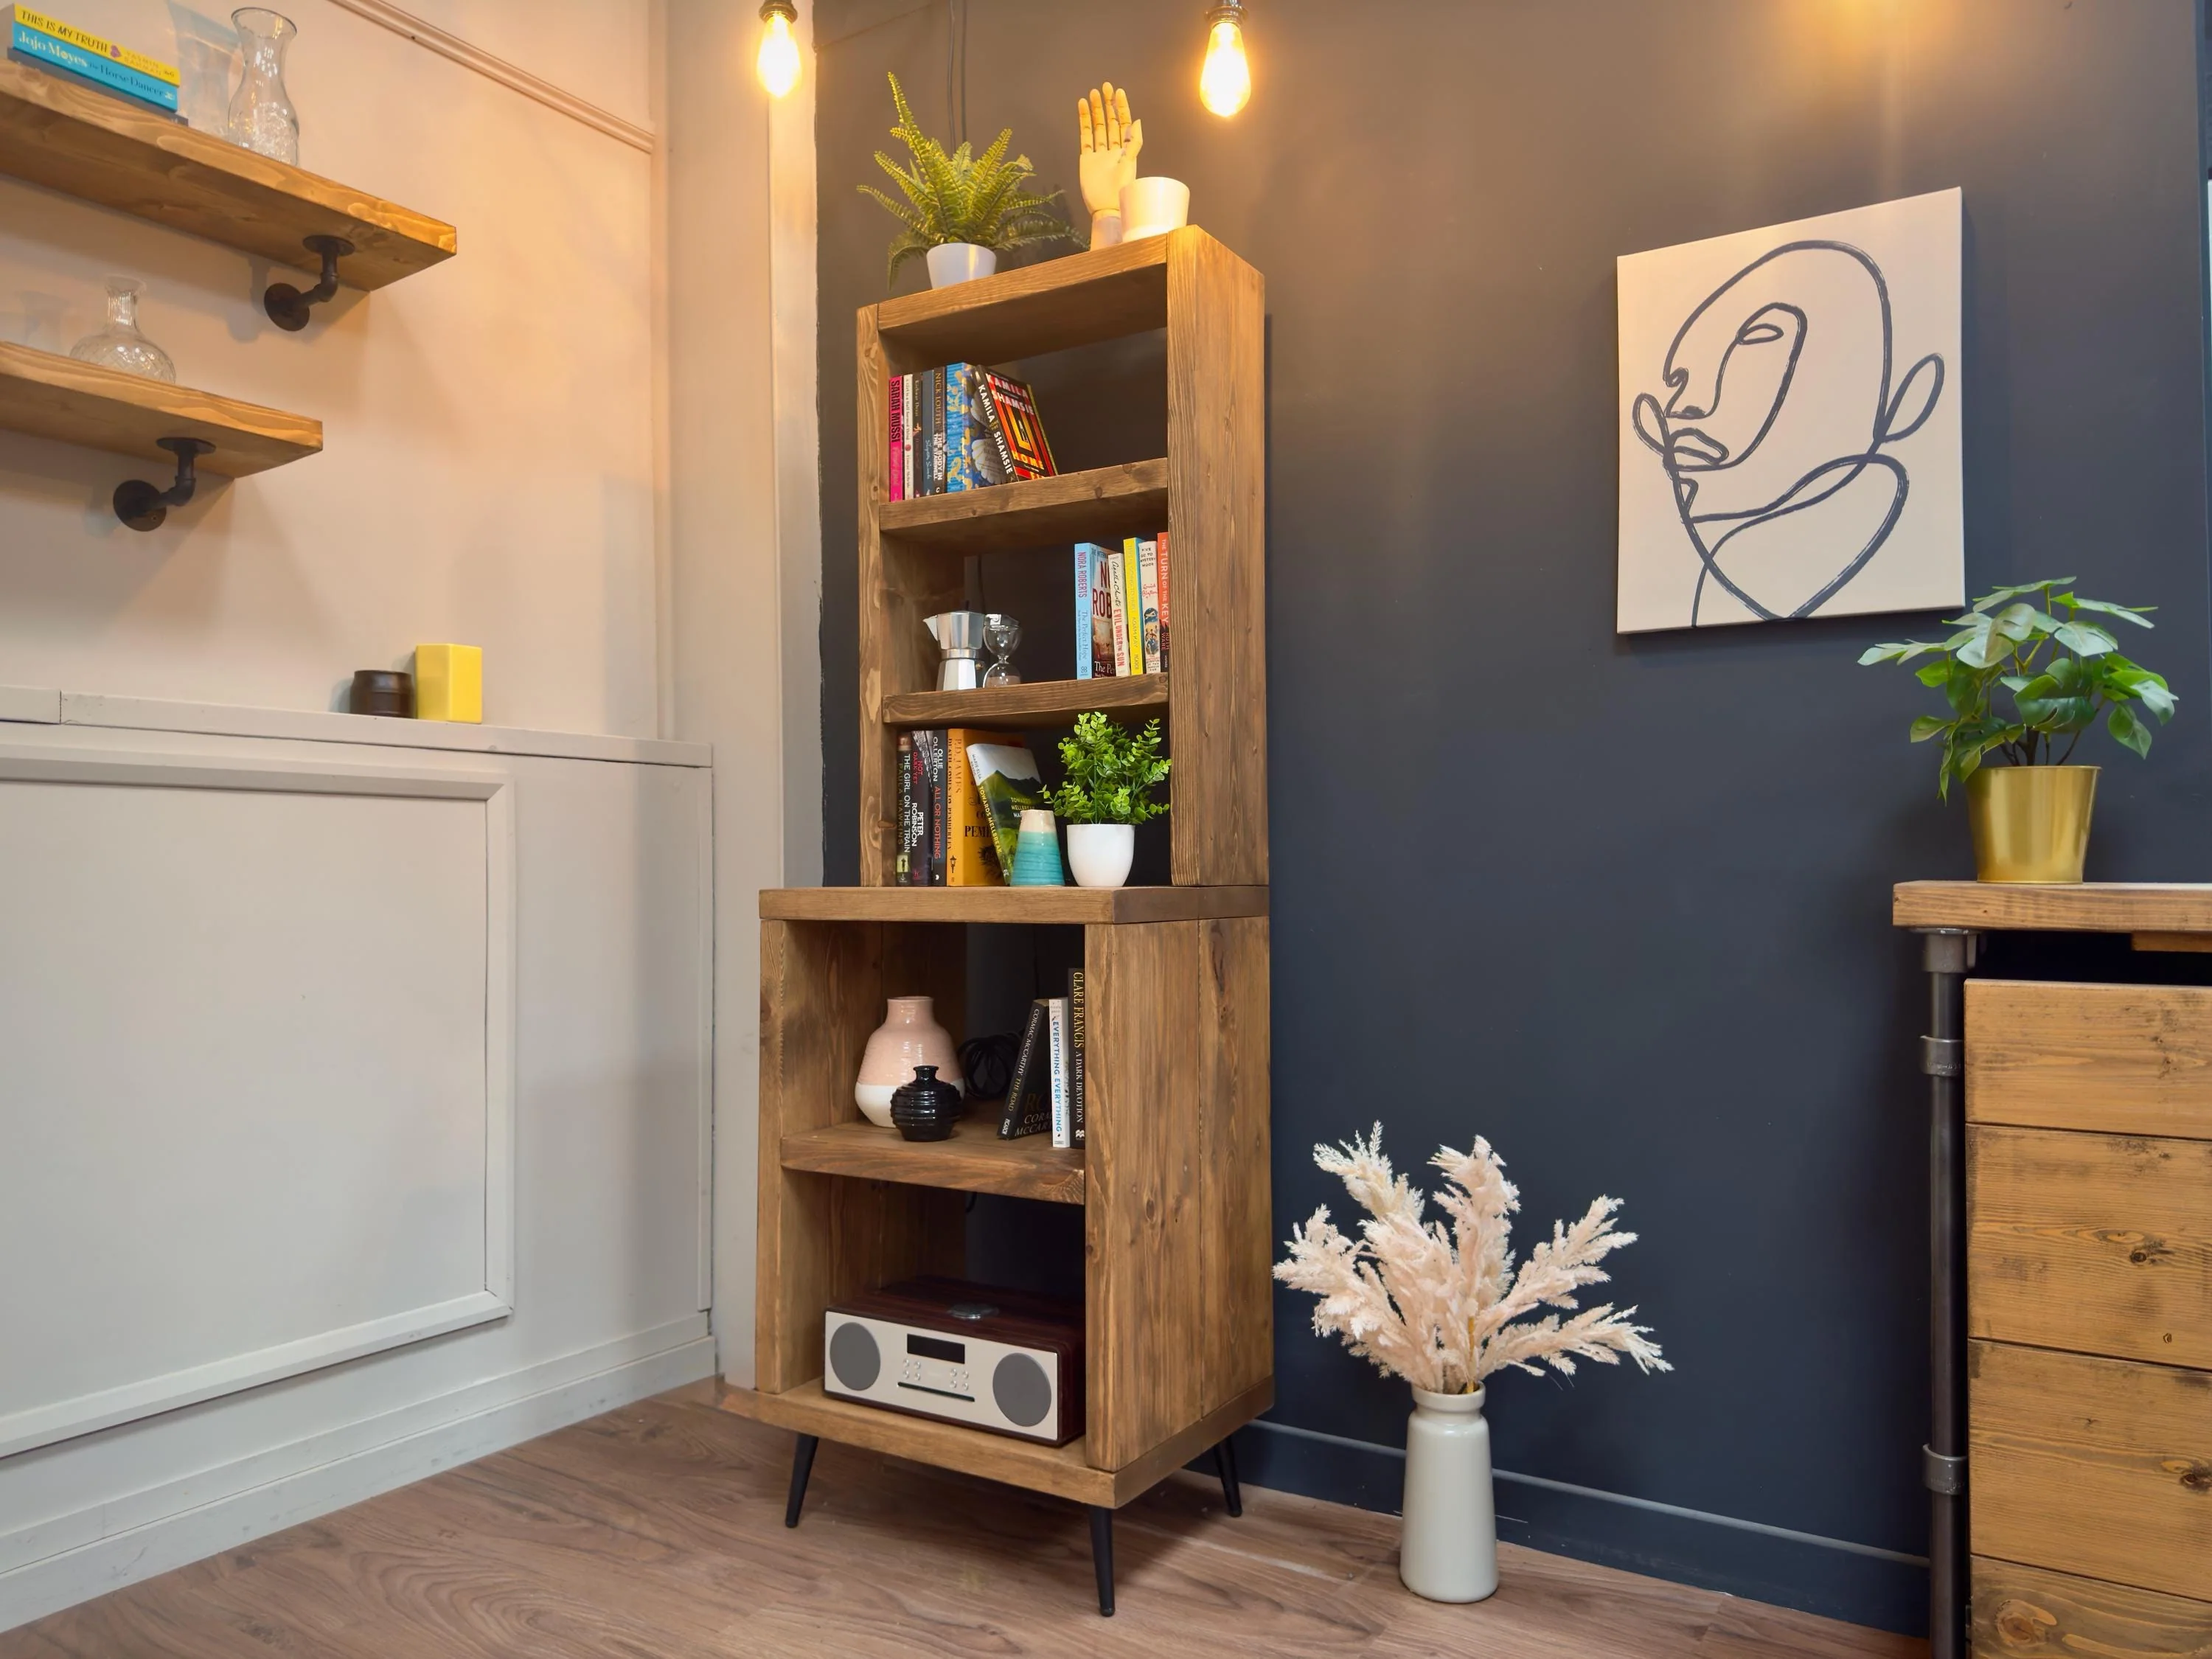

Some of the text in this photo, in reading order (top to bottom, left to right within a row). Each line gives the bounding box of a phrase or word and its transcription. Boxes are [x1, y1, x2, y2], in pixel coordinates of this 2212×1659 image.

[21, 10, 108, 53] THIS IS MY TRUTH
[18, 30, 87, 67] Jojo Moyes
[100, 64, 129, 83] Horse
[130, 76, 164, 97] Dancer
[891, 380, 901, 411] SARAH
[986, 373, 1029, 399] KAMILA
[978, 384, 995, 422] KAMILA
[891, 412, 902, 442] MUSSI
[993, 431, 1013, 474] SHAMSIE
[937, 472, 943, 481] IN
[1077, 552, 1088, 598] NORA ROBERTS
[1161, 552, 1169, 580] TURN
[1113, 608, 1122, 625] EVIL
[1161, 603, 1169, 625] KEY
[1115, 625, 1124, 645] UNDER
[1094, 661, 1105, 672] The
[1116, 653, 1125, 667] SUN
[953, 759, 962, 793] JAMES
[904, 795, 911, 808] ON
[934, 803, 942, 817] OR
[979, 785, 1003, 855] TOWARDS MELLBREAK
[1027, 1009, 1040, 1039] CORMAC
[1073, 972, 1085, 1048] CLARE FRANCIS
[1008, 1091, 1018, 1112] ROAD
